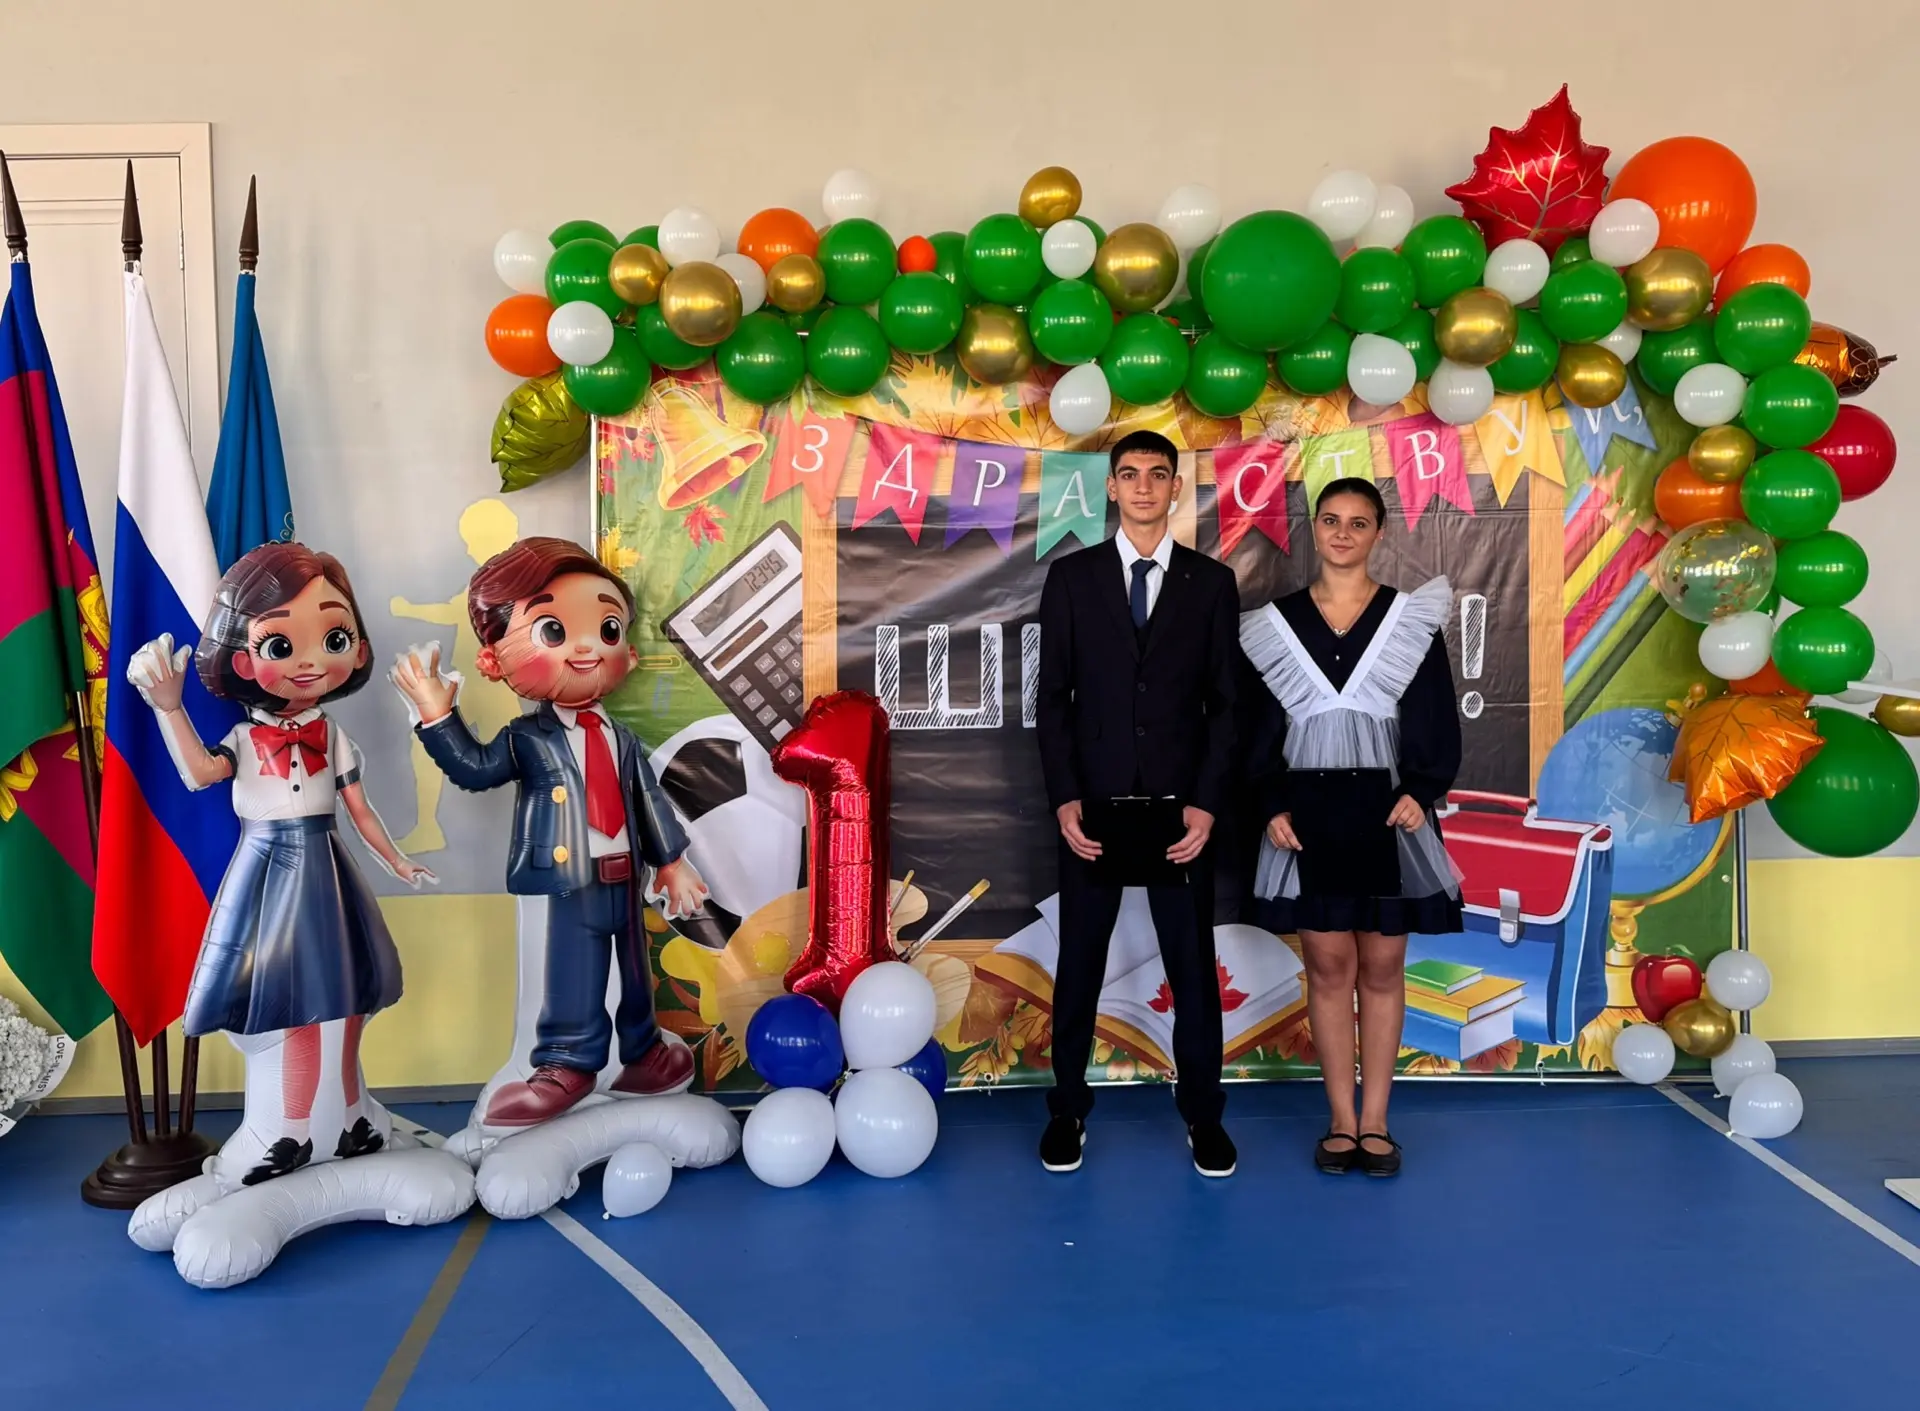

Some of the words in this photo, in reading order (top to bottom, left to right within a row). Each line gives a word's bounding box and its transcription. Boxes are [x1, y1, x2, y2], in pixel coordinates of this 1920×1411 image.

[791, 399, 1643, 518] ЗДРАСТВУ,
[743, 554, 783, 593] 12345
[791, 658, 801, 669] 8
[773, 673, 783, 684] 7
[787, 688, 796, 698] 4
